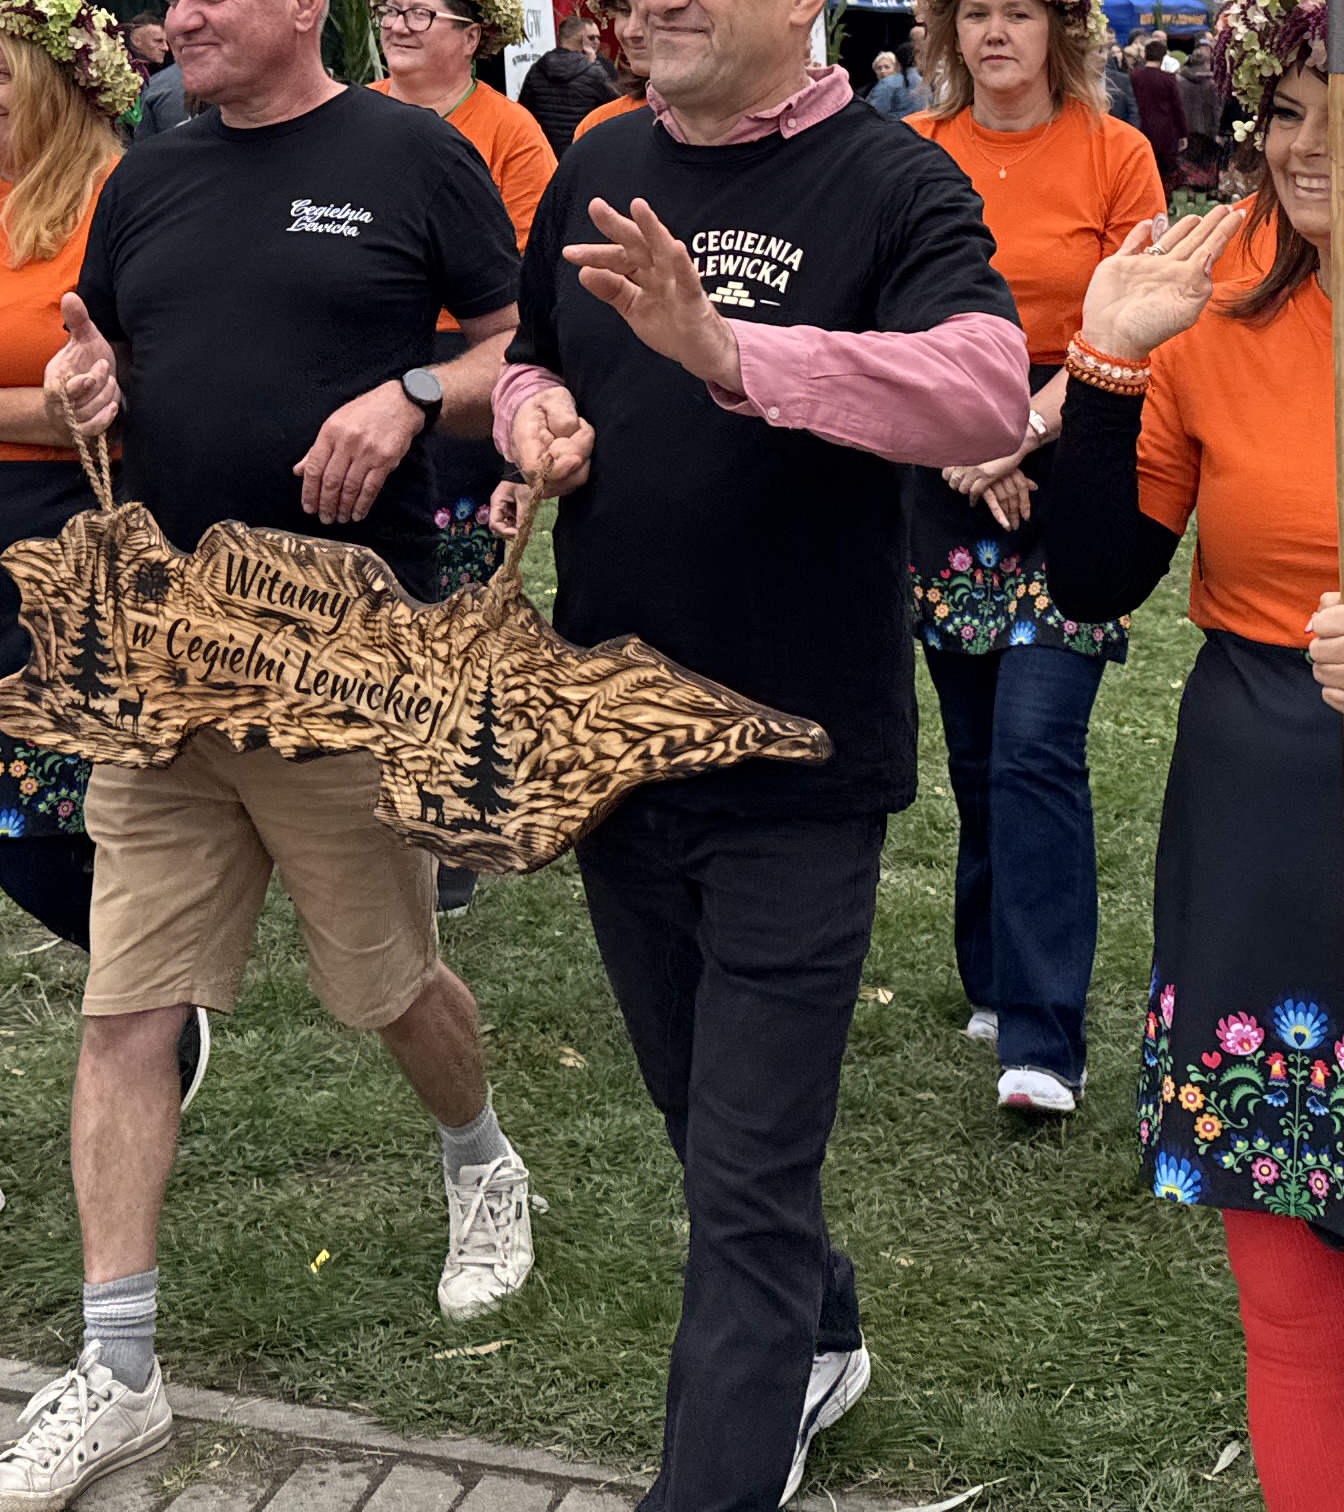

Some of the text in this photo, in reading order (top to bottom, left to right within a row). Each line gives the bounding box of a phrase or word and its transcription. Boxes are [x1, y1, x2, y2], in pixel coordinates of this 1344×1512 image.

[286, 215, 361, 237] Lewicka
[290, 199, 374, 224] Cegielnia
[691, 229, 804, 272] CEGIELNIA
[693, 254, 790, 294] LEWICKA
[225, 552, 351, 636] Witamy
[132, 618, 449, 744] w Cegielni Lewickiej
